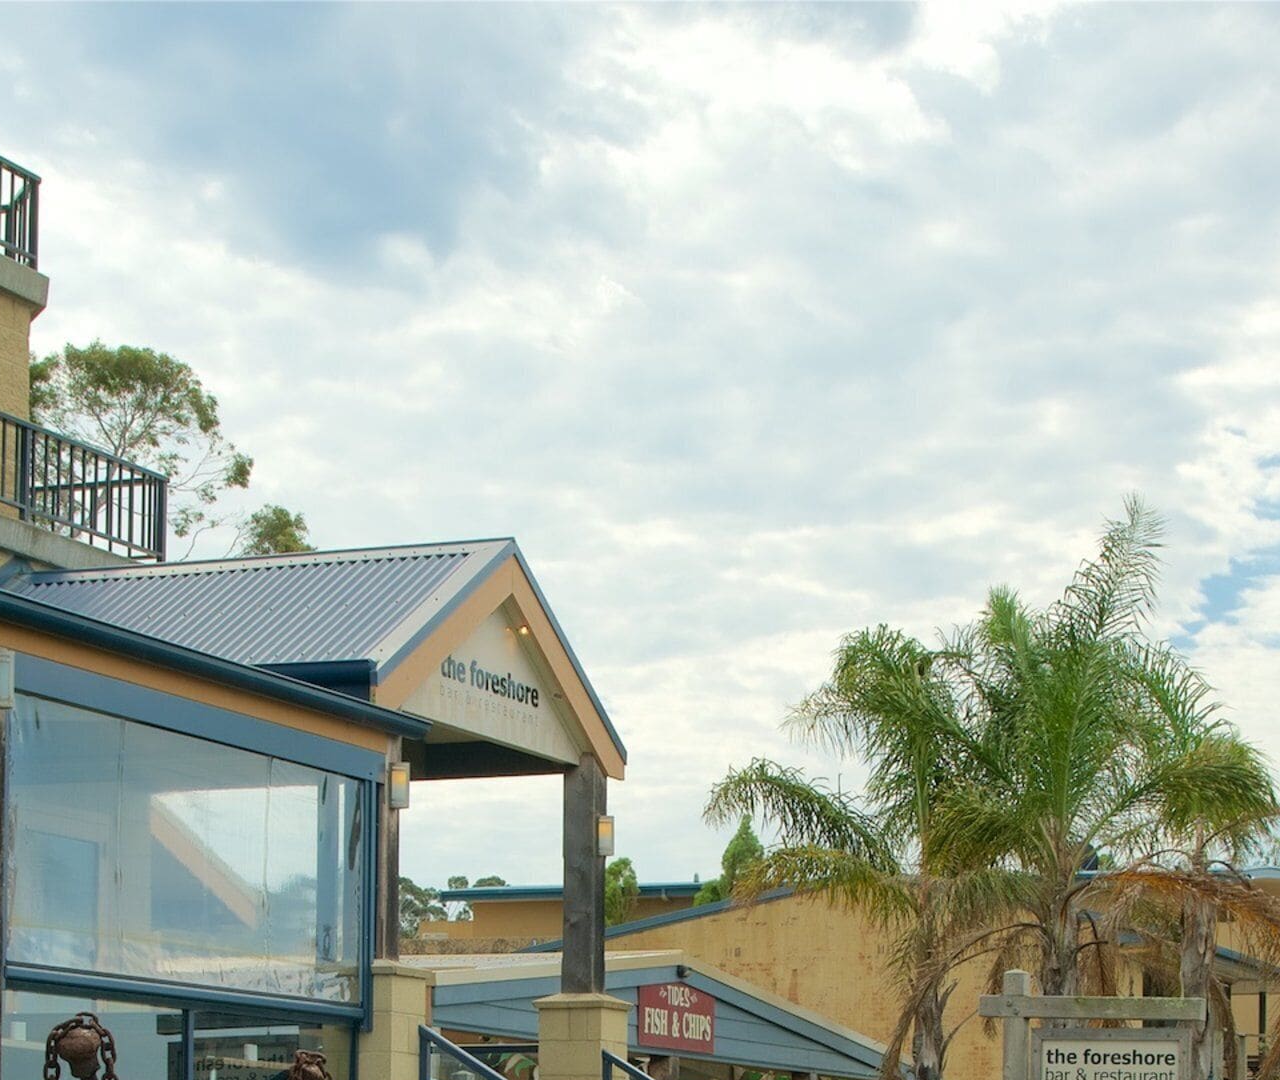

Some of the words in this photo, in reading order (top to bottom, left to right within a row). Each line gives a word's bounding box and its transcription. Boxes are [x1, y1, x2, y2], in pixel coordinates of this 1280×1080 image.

[441, 655, 466, 683] the
[469, 660, 539, 708] foreshore
[667, 985, 690, 1008] TIDES
[644, 1007, 668, 1036] FISH
[672, 1011, 680, 1037] &
[683, 1012, 712, 1042] CHIPS
[1046, 1048, 1077, 1065] the
[1083, 1048, 1176, 1066] foreshore
